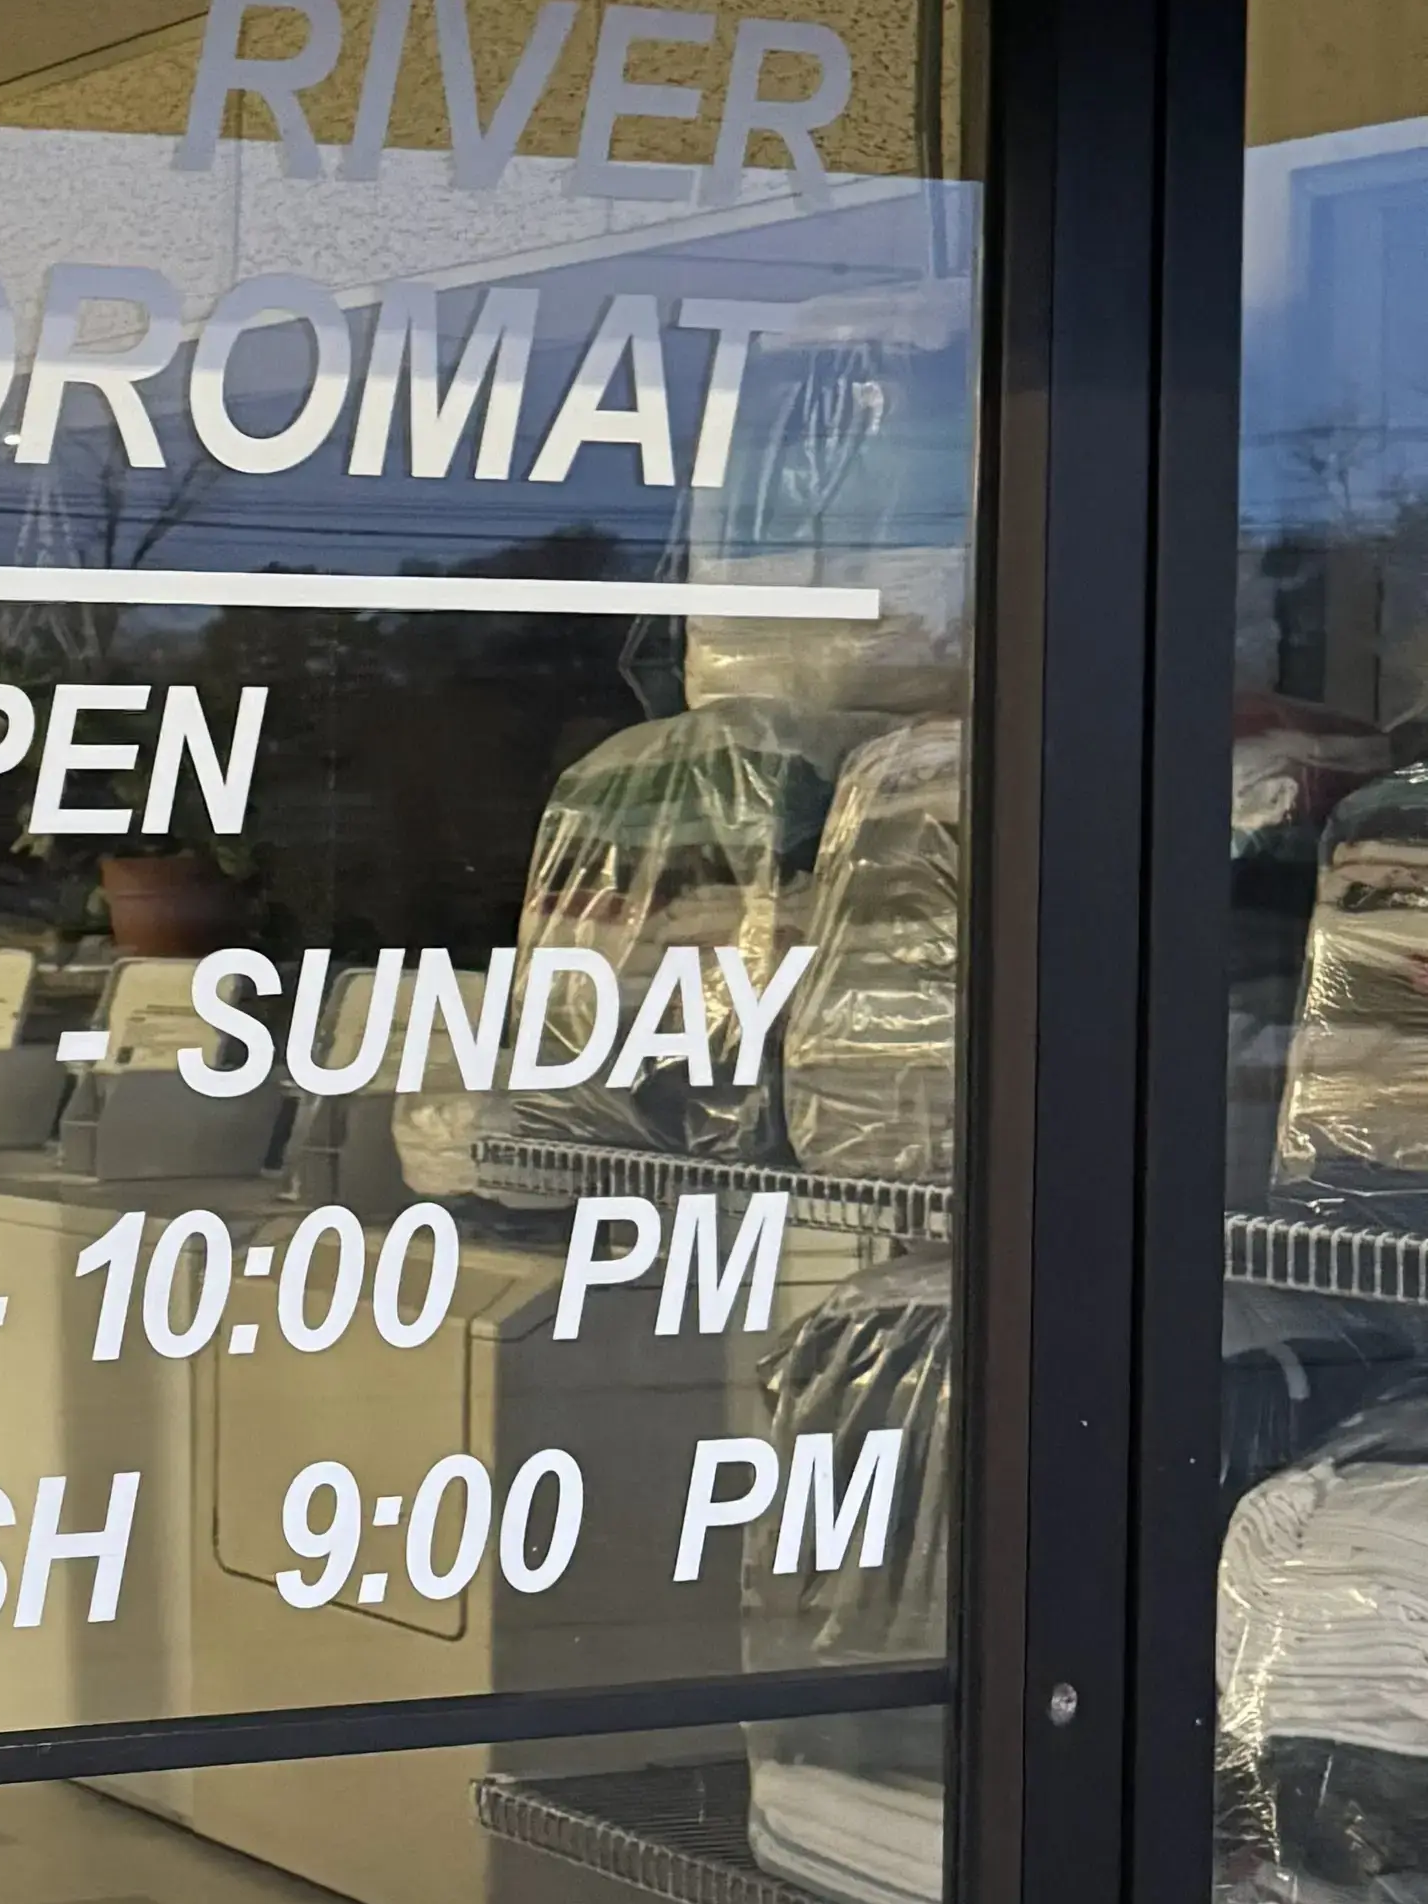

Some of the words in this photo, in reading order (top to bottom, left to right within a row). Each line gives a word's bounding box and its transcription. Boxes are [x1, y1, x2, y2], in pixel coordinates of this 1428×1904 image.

[177, 945, 818, 1097] SUNDAY
[73, 1202, 460, 1361] 10:00
[552, 1190, 790, 1341] PM
[274, 1448, 585, 1610] 9:00
[673, 1428, 904, 1583] PM
